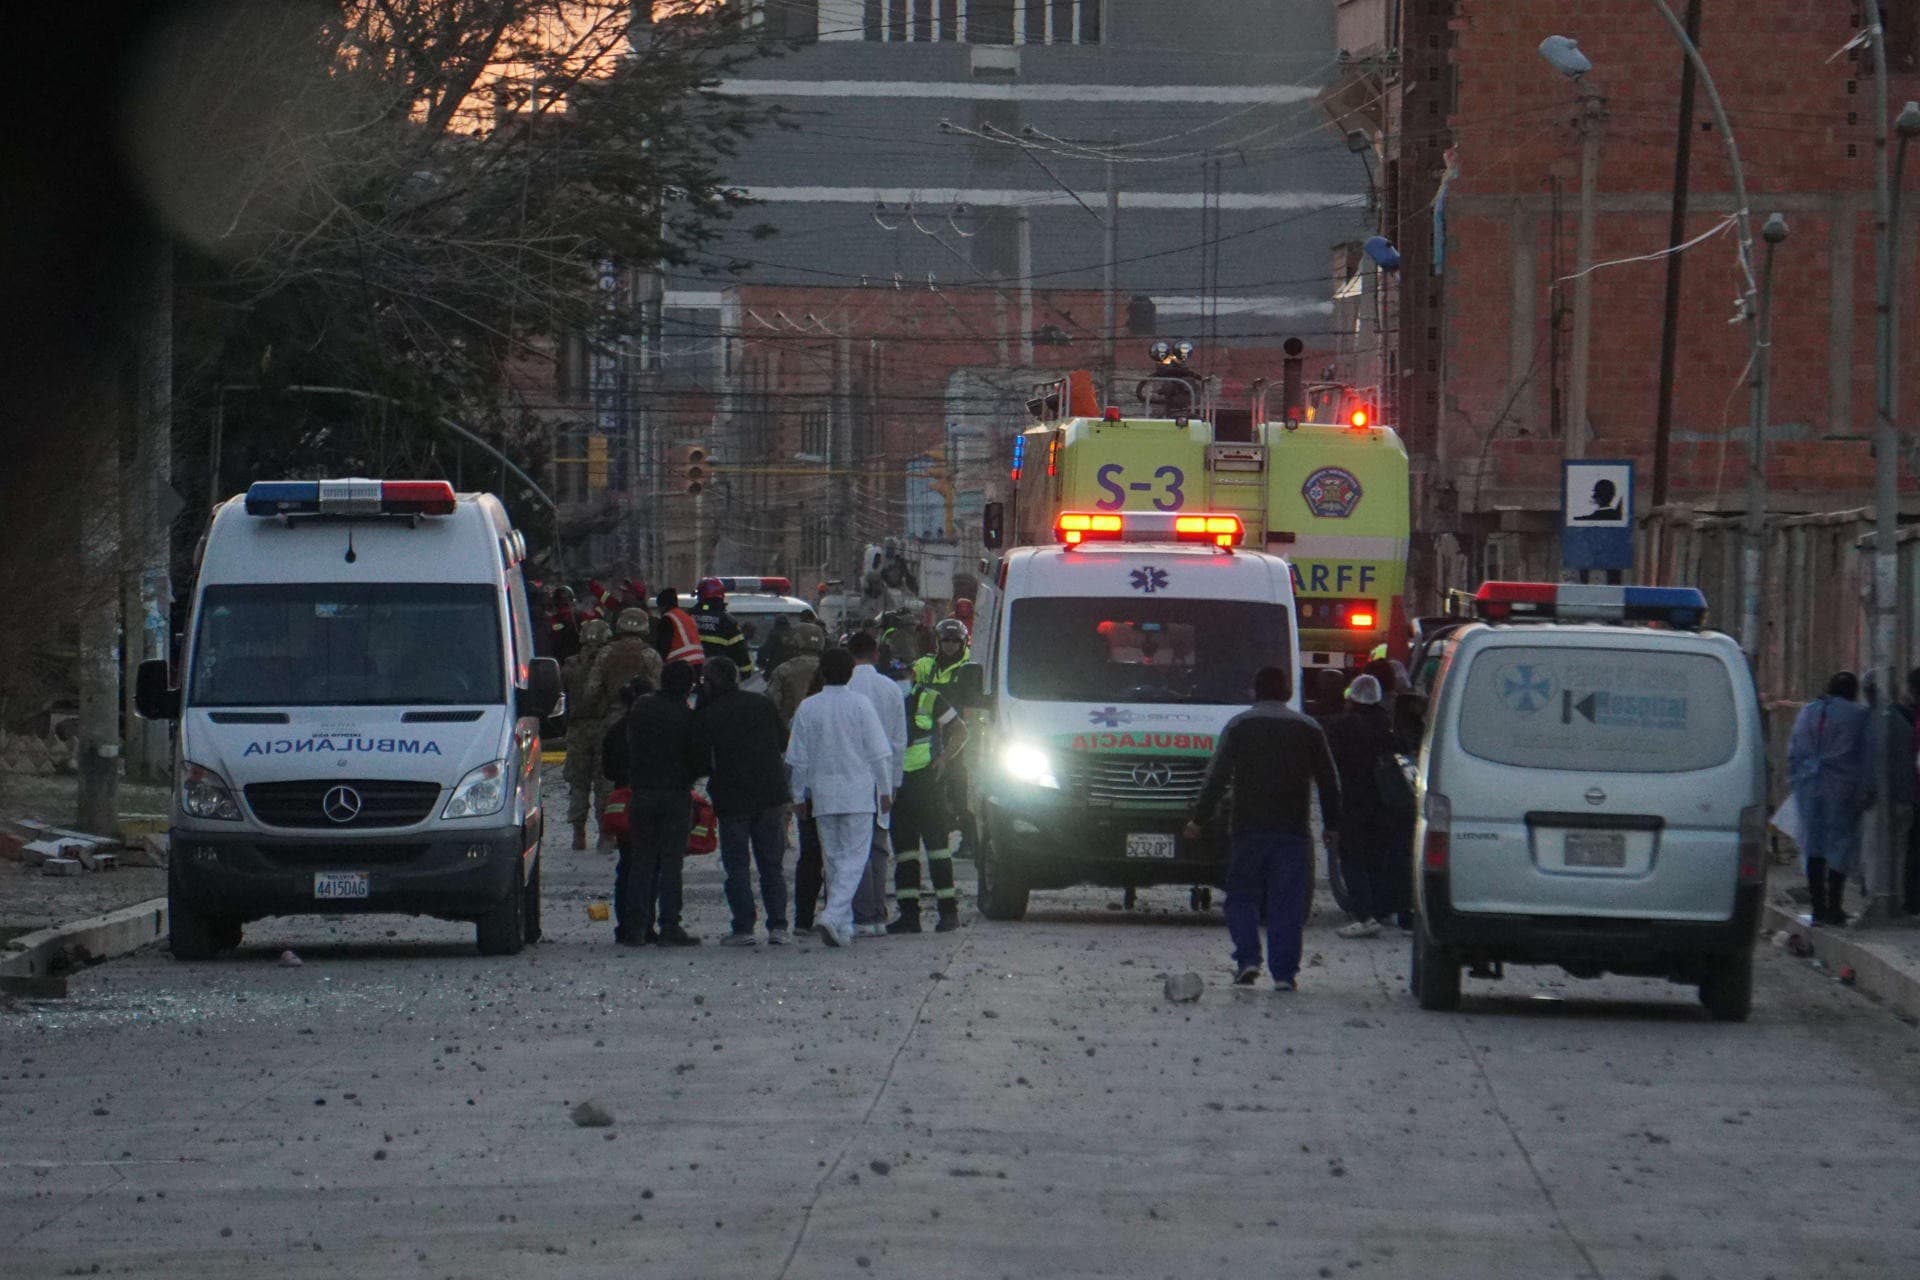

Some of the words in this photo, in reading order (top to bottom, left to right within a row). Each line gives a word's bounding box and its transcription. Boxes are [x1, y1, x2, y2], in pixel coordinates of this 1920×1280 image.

[1096, 464, 1184, 512] S-3
[1288, 564, 1376, 592] ARFF
[317, 880, 366, 896] 4415DAG
